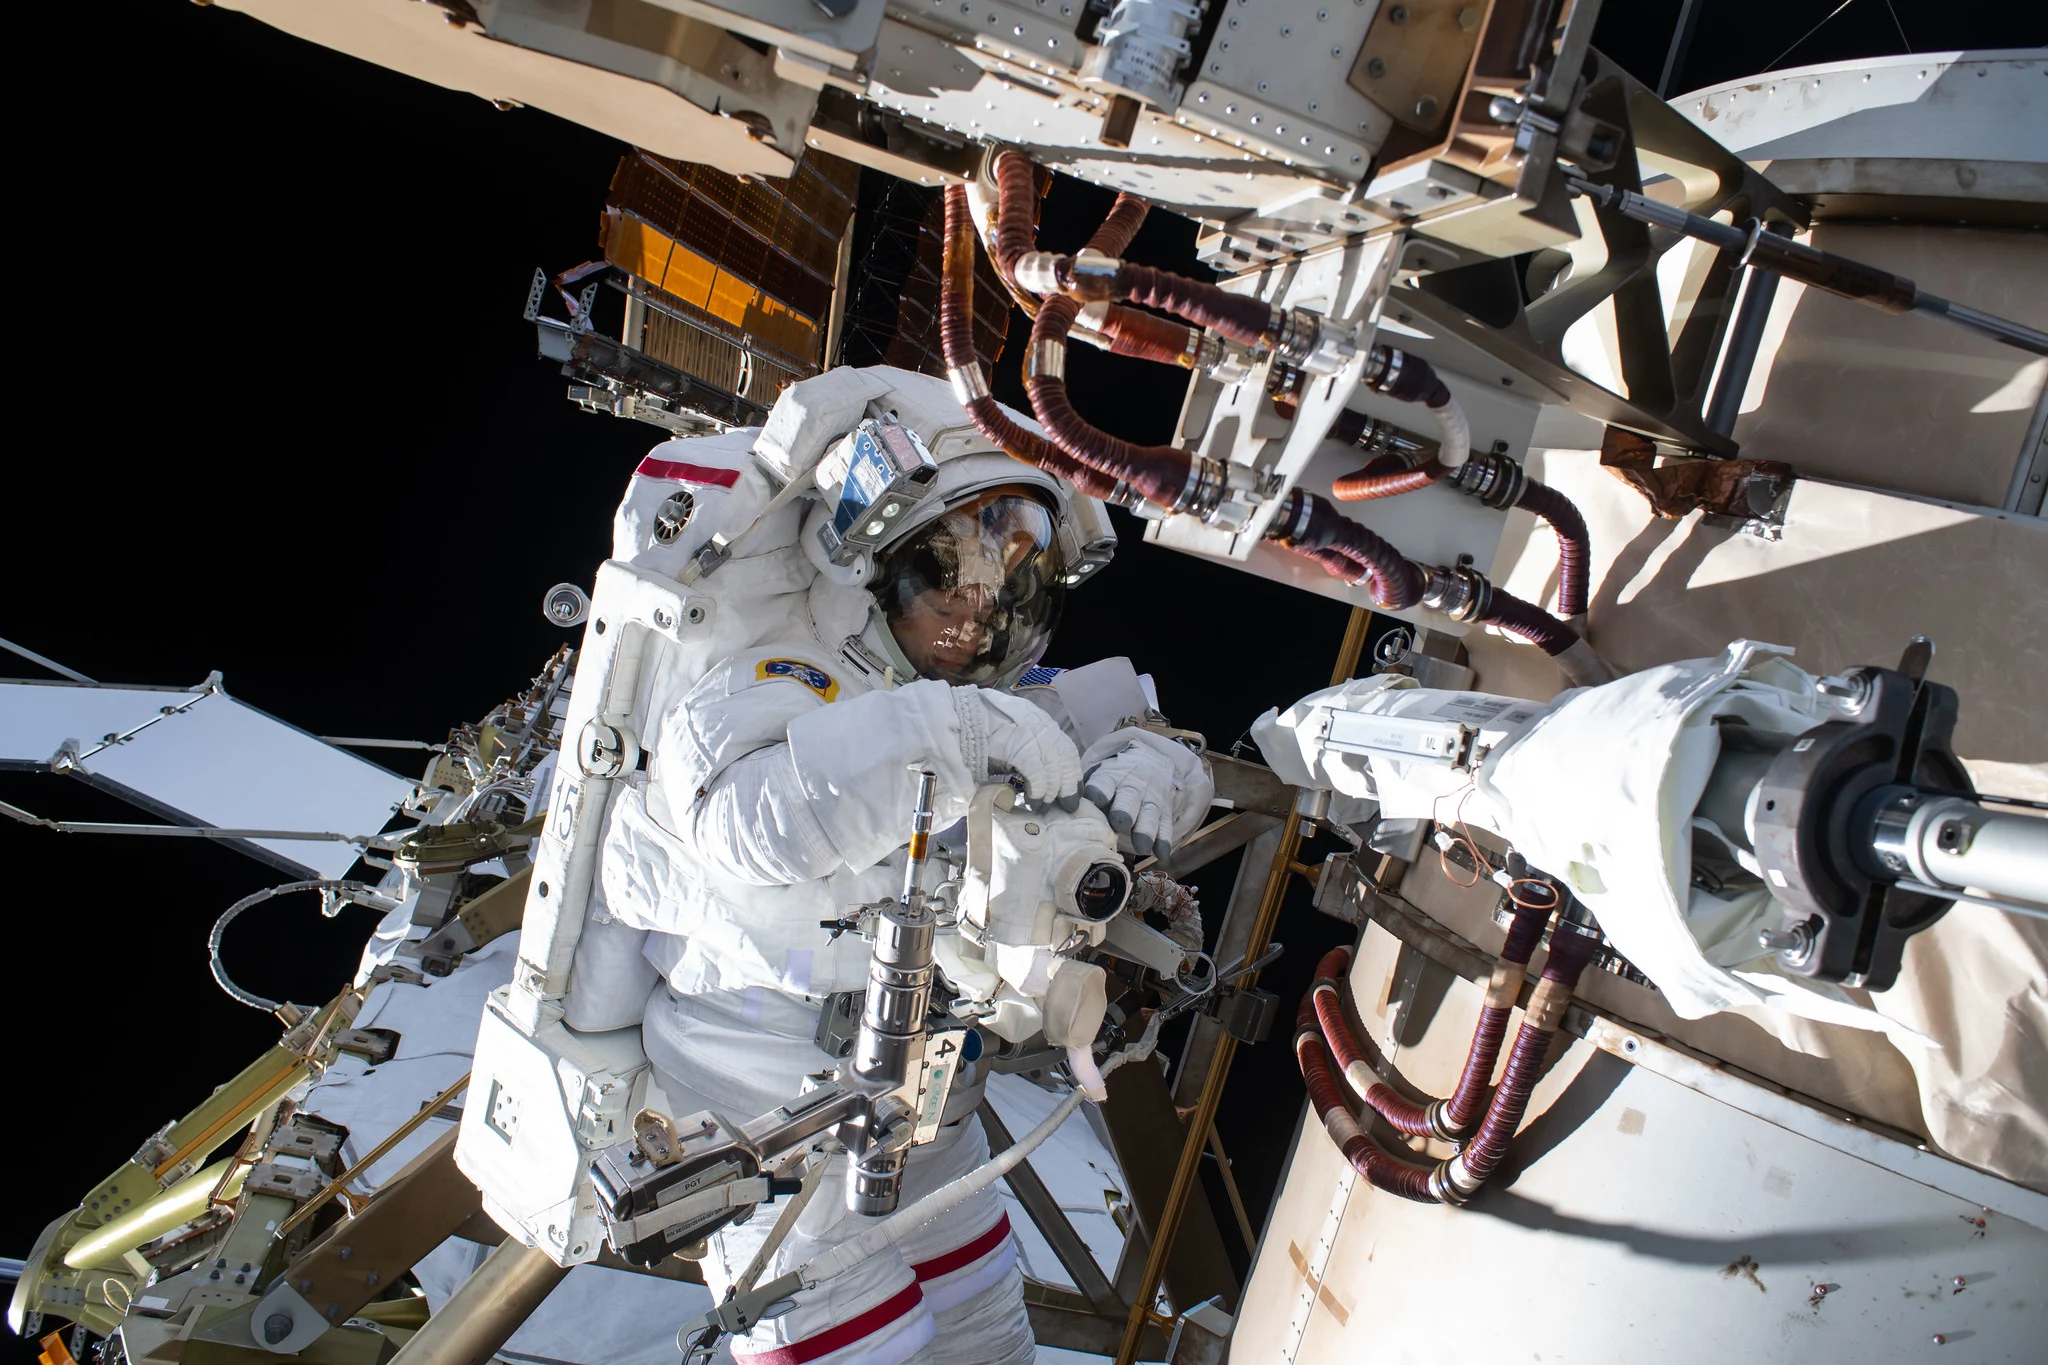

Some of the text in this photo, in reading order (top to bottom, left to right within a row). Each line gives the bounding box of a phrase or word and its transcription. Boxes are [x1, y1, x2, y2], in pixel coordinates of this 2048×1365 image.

[552, 777, 579, 841] 15
[935, 1038, 957, 1059] 4
[684, 1177, 702, 1191] PGT
[735, 1306, 744, 1315] L
